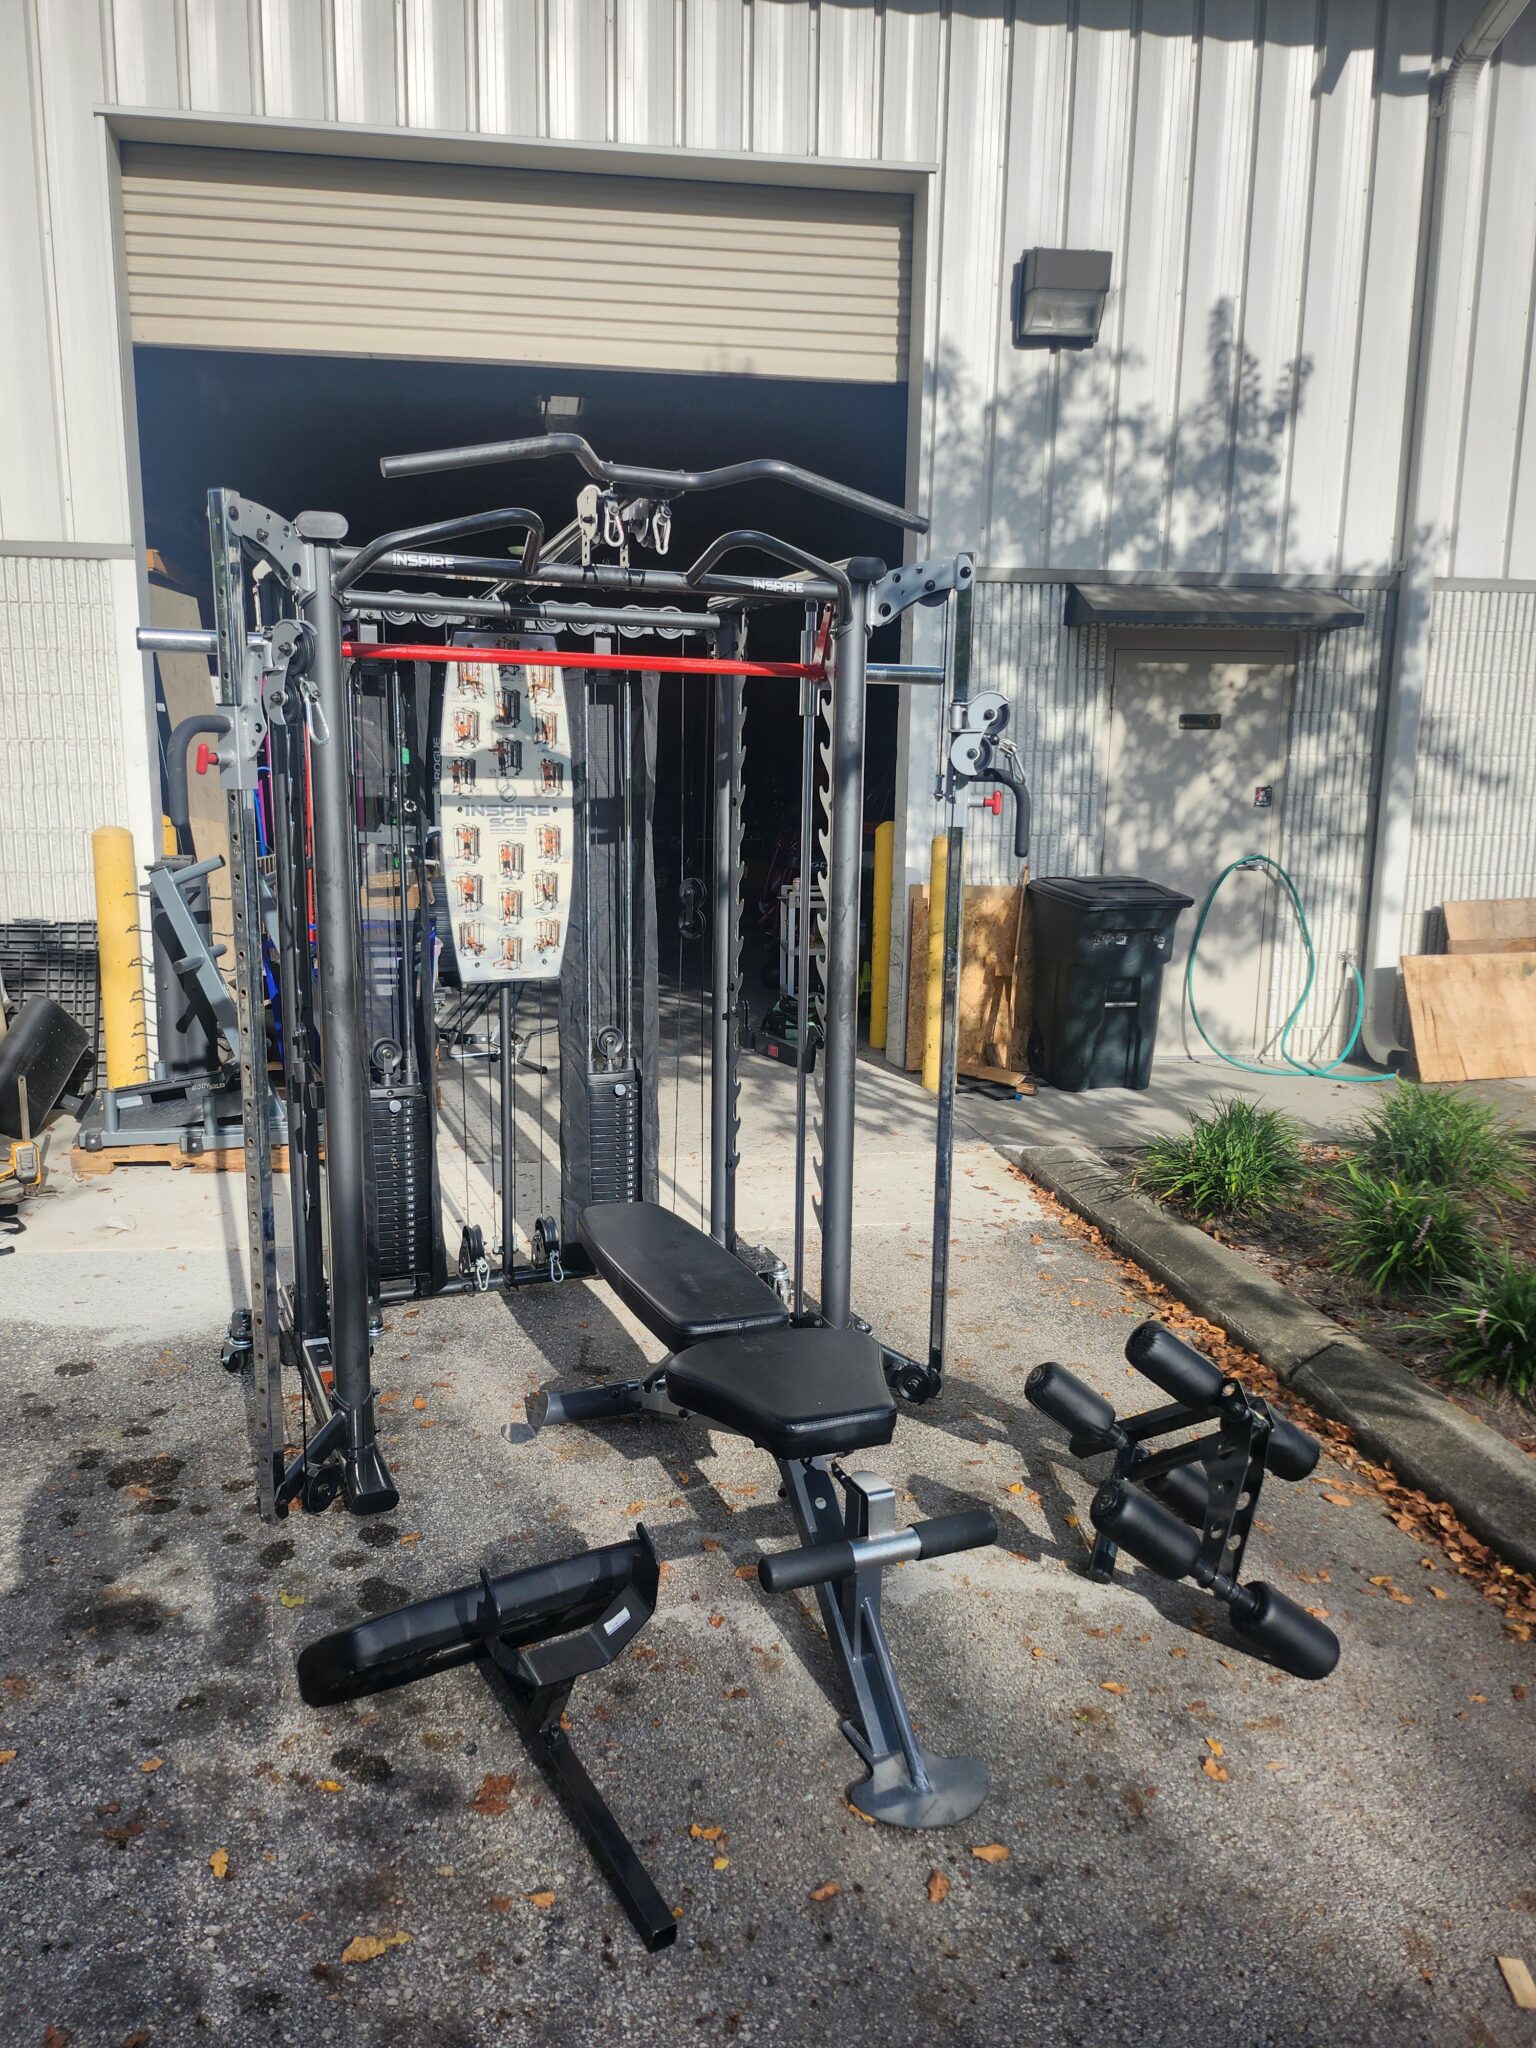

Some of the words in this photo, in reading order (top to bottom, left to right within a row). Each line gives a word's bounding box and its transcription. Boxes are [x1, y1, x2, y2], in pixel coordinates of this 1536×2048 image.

[392, 553, 455, 569] INSPIRE
[752, 579, 804, 593] INSPIRE
[433, 737, 441, 780] ROGUE
[465, 804, 550, 817] INSPIRE
[489, 818, 528, 828] SCS
